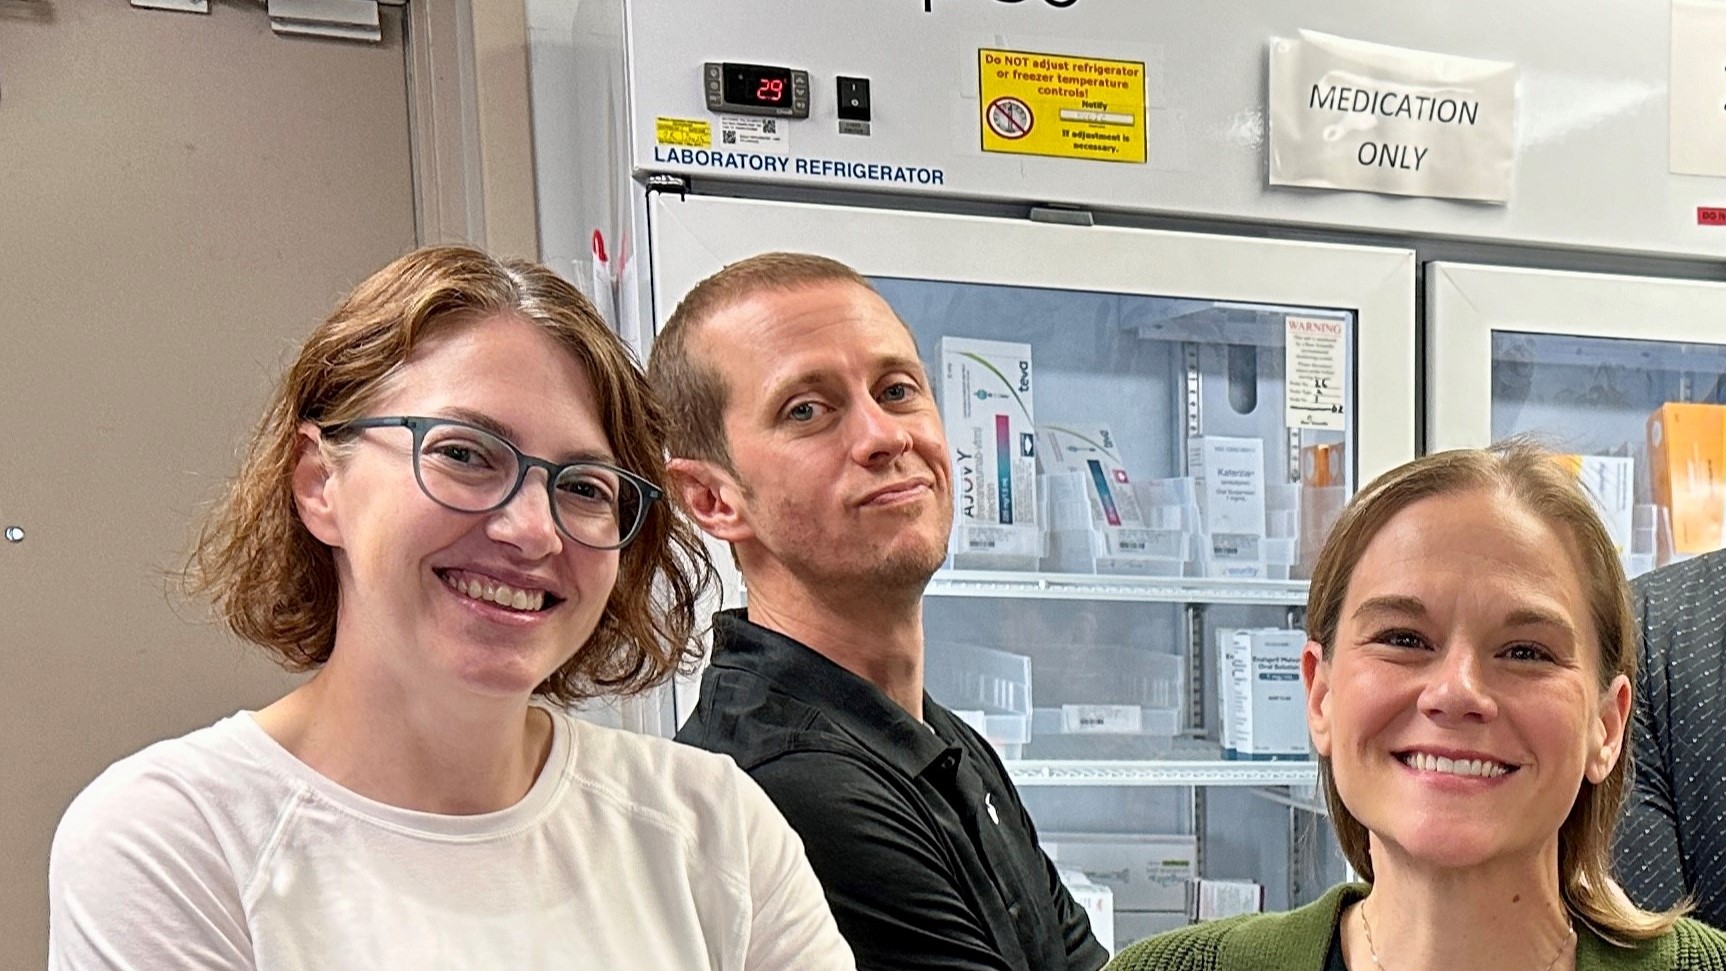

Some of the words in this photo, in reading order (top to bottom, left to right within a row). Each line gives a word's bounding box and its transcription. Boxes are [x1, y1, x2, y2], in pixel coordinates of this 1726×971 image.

[985, 54, 1002, 65] Do
[1005, 55, 1030, 67] NOT
[1032, 59, 1069, 72] adjust
[1072, 62, 1139, 77] refrigerator
[756, 78, 783, 101] 29
[996, 70, 1009, 78] or
[1013, 69, 1055, 83] freezer
[1057, 73, 1129, 90] temperature
[1038, 86, 1089, 99] controls!
[1309, 83, 1479, 125] MEDICATION
[1072, 130, 1121, 142] adjustment
[654, 146, 789, 173] LABORATORY
[795, 158, 944, 185] REFRIGERATOR
[1357, 141, 1429, 171] ONLY
[1702, 211, 1717, 220] DO
[1288, 320, 1342, 335] WARNING
[1018, 361, 1030, 393] teva
[956, 448, 974, 518] AJOVY
